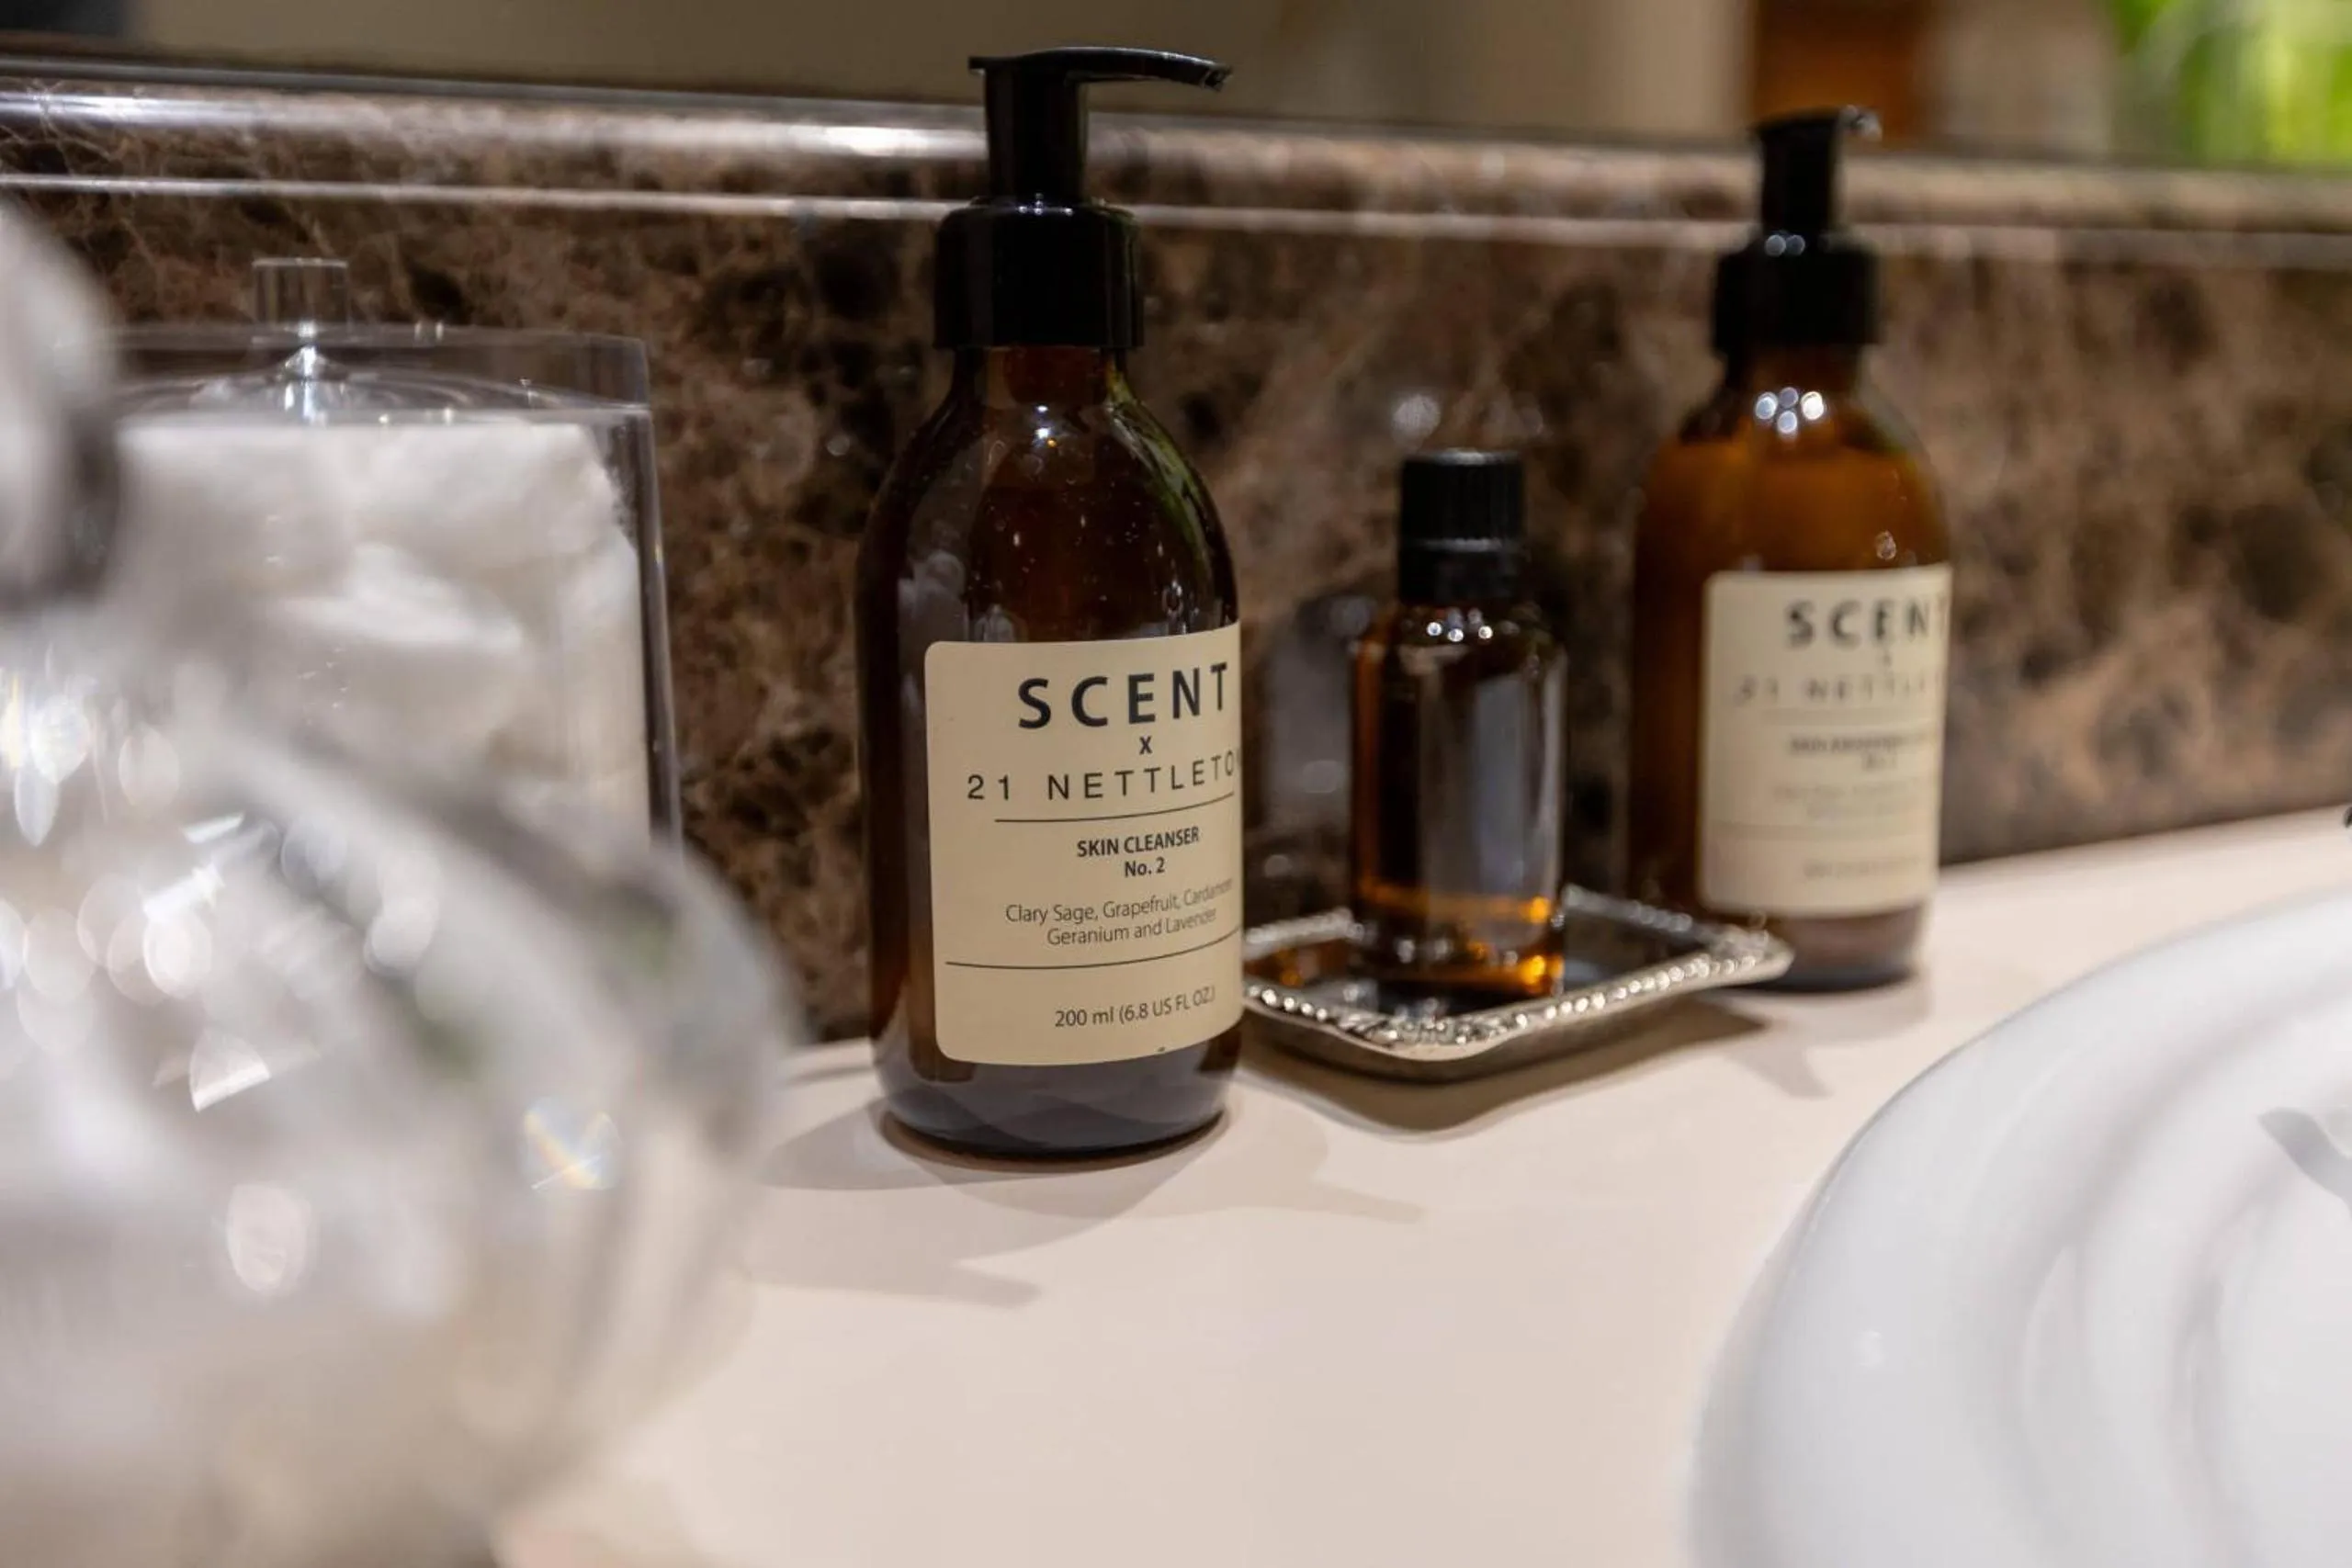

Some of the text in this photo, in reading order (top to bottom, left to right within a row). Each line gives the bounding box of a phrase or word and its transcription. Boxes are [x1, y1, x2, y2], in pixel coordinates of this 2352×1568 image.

[1018, 661, 1227, 728] SCENT
[967, 774, 1010, 800] 21
[1077, 826, 1200, 857] SKIN CLEANSER
[1124, 857, 1165, 878] No. 2
[1005, 904, 1048, 925] Clary
[1053, 904, 1099, 924] Sage,
[1046, 921, 1130, 945] Geranium
[1134, 920, 1162, 939] and
[1055, 1010, 1088, 1027] 200
[1092, 1006, 1114, 1024] ml
[1119, 1002, 1148, 1024] (6.8
[1152, 998, 1172, 1017] US
[1175, 994, 1191, 1011] FL
